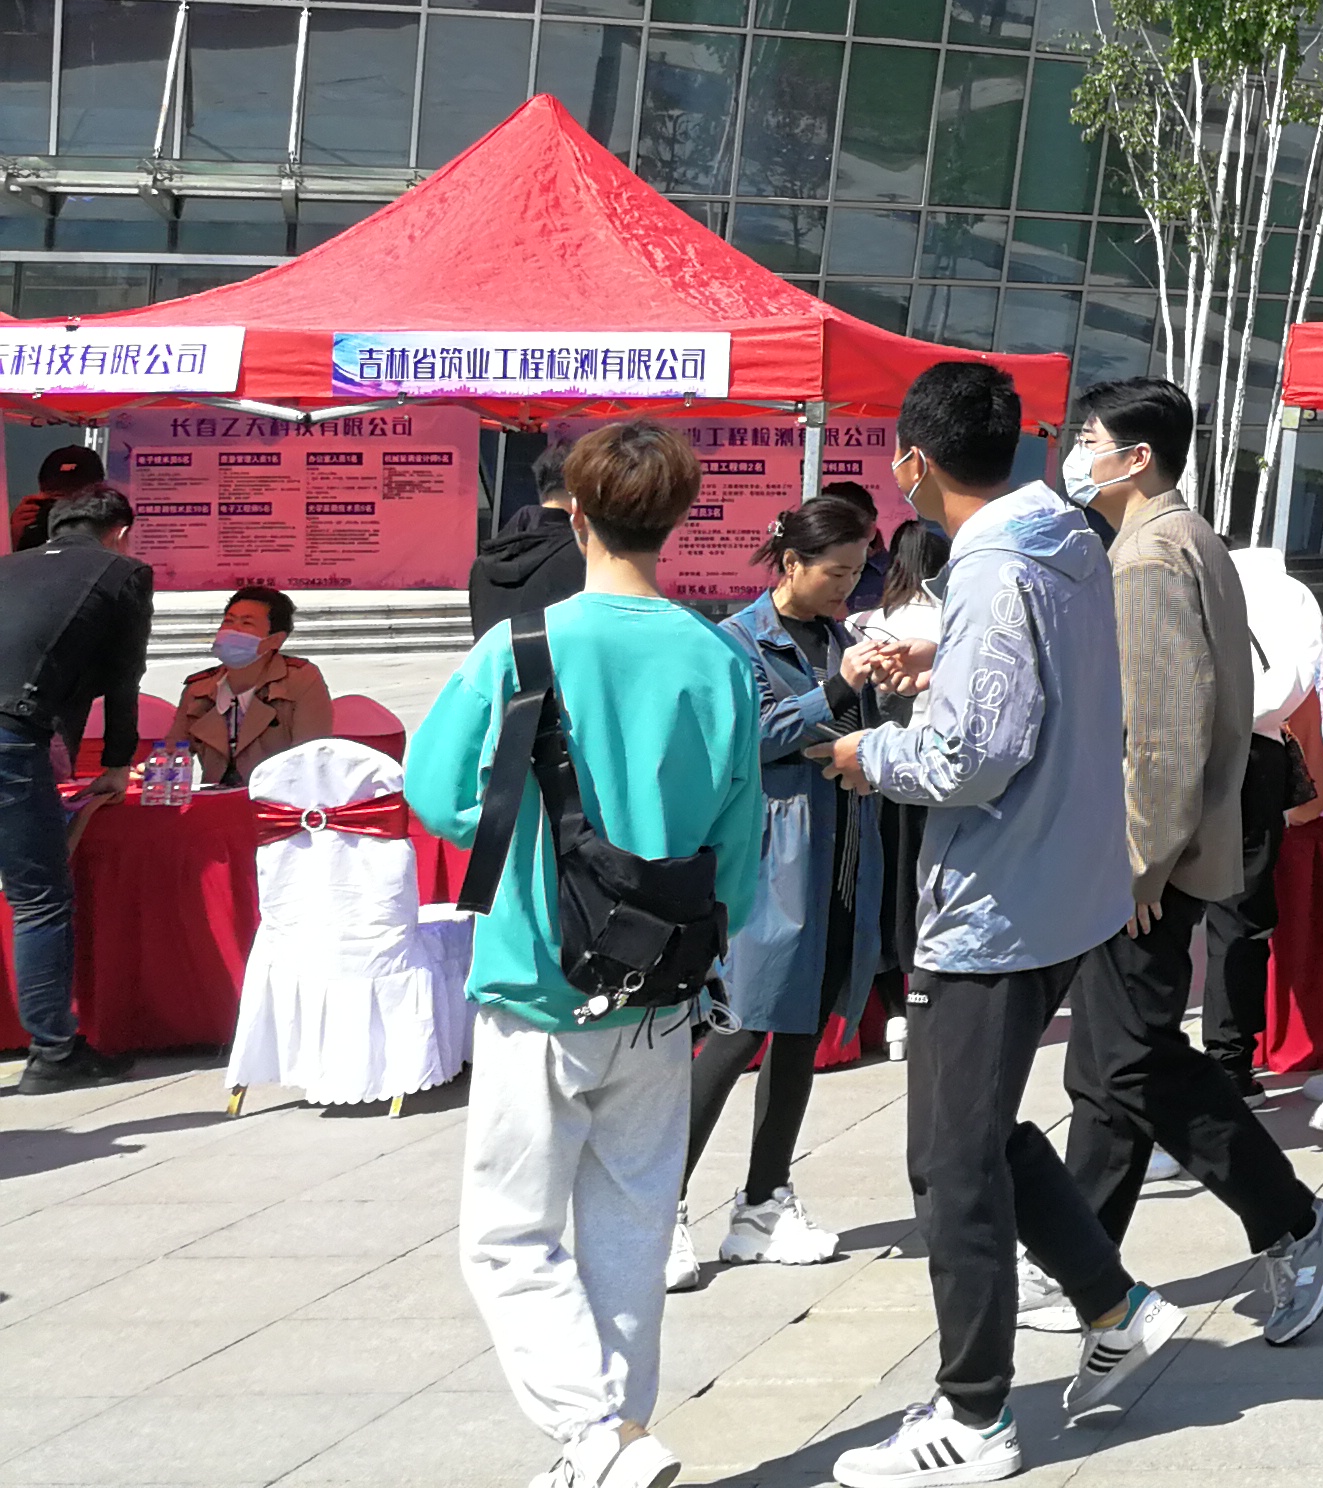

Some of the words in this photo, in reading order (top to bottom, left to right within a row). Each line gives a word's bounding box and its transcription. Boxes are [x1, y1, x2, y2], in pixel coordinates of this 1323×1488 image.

[358, 347, 706, 382] 吉林省筑业工程检测有限公司
